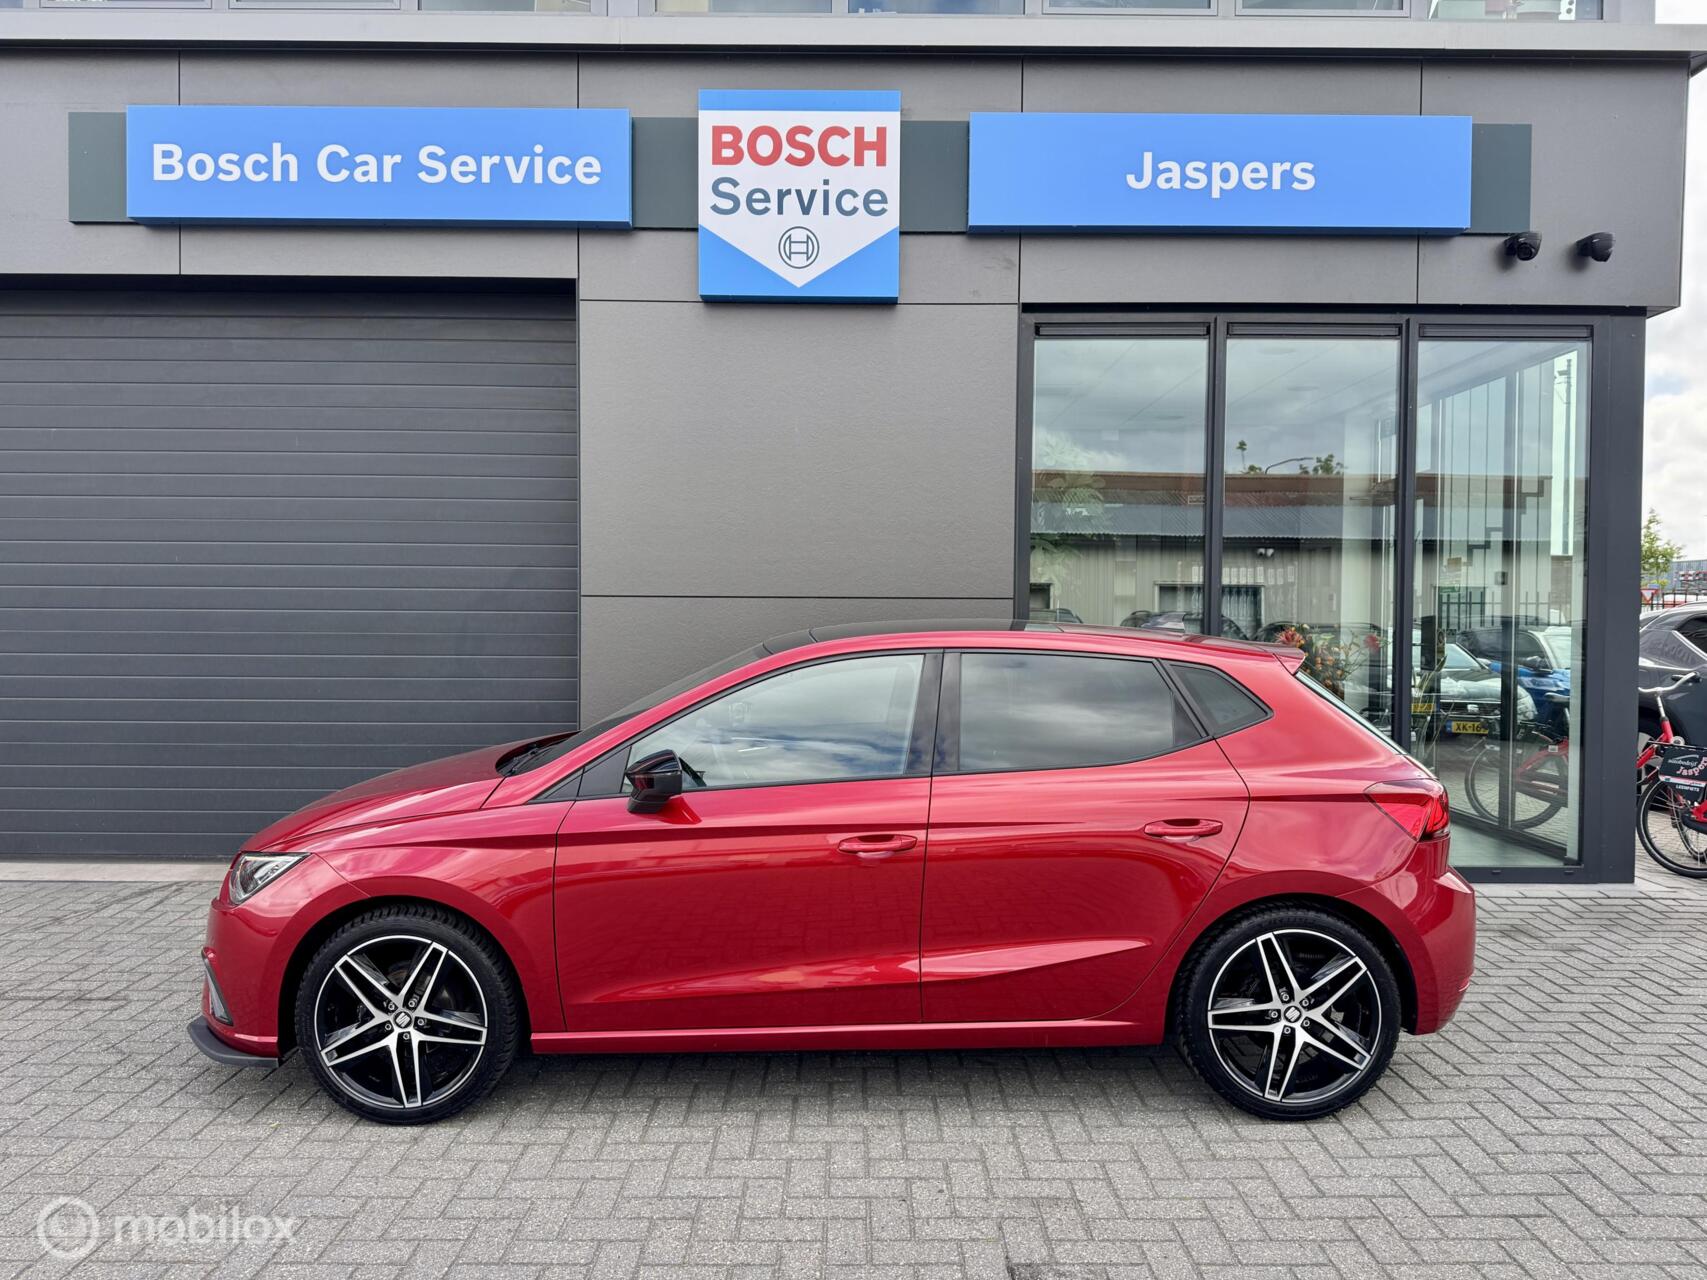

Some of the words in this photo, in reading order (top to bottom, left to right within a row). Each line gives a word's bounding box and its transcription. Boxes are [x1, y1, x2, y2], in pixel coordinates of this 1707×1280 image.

[153, 142, 298, 182] Bosch
[316, 144, 402, 183] Car
[417, 144, 602, 185] Service
[711, 125, 887, 167] BOSCH
[1126, 151, 1316, 199] Jaspers
[710, 176, 889, 217] Service
[1455, 722, 1488, 733] XK-16
